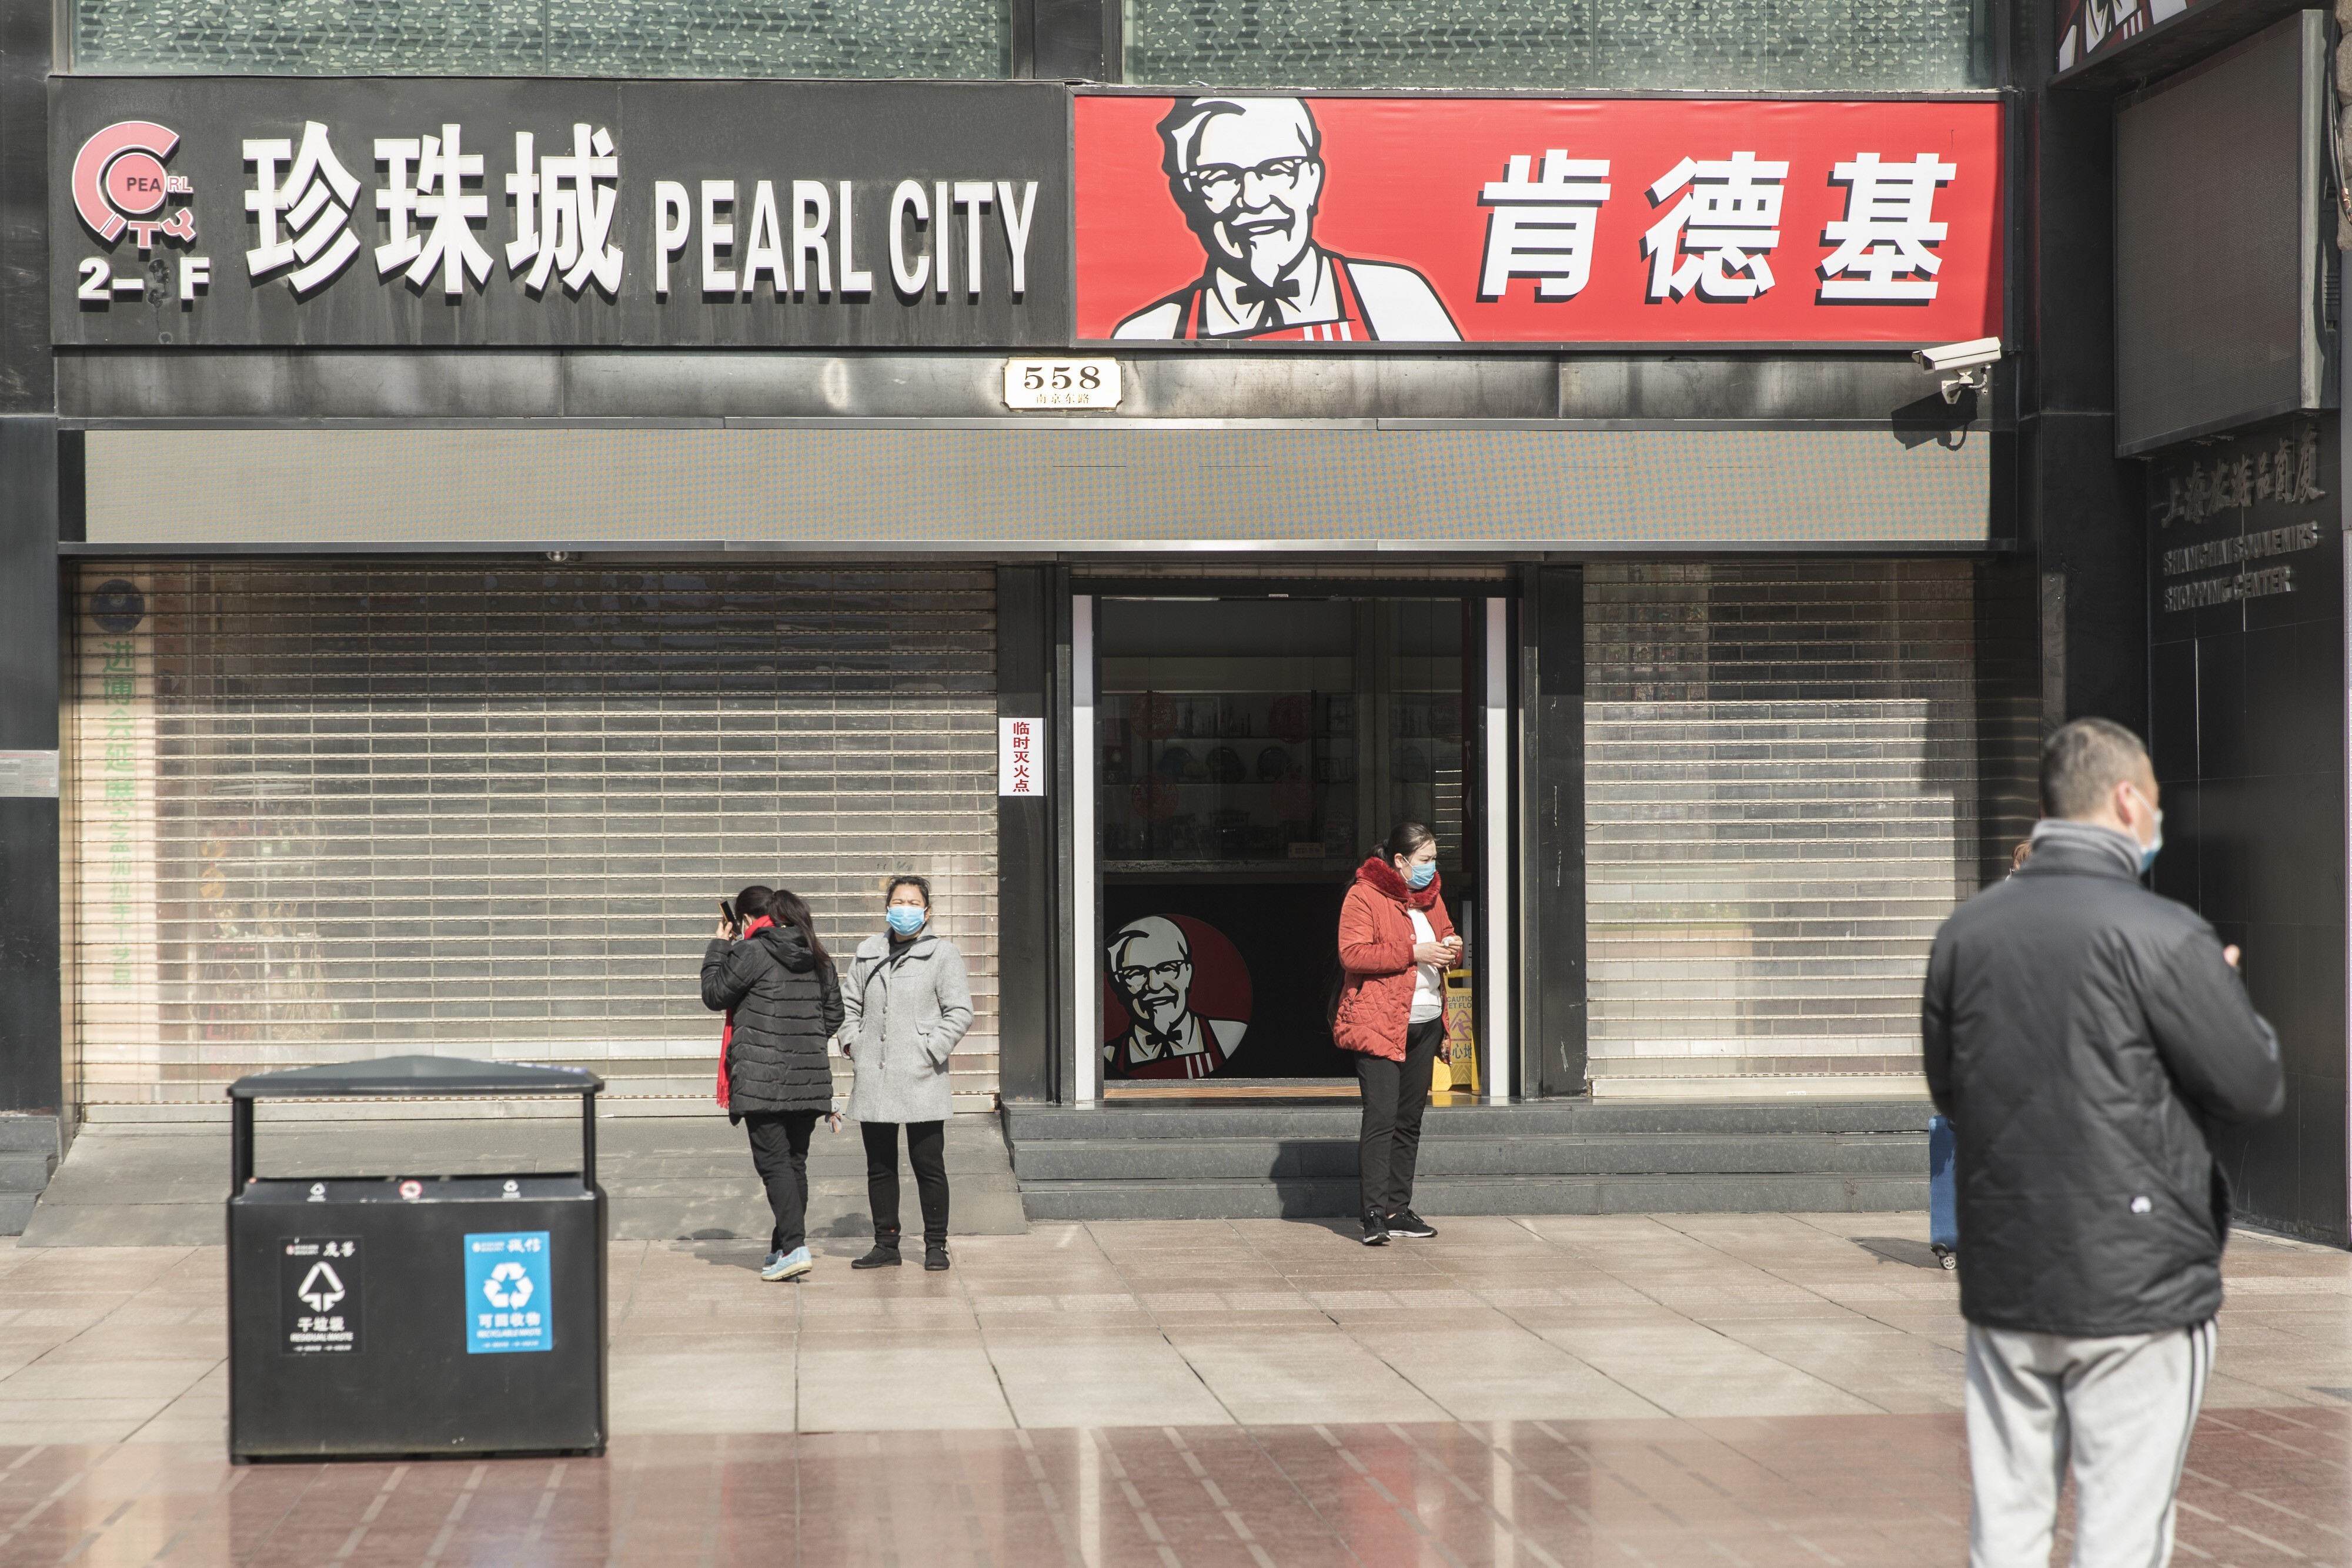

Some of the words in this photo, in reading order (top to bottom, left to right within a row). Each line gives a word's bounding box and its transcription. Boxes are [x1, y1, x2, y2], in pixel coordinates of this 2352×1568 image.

[242, 121, 624, 295] 珍珠城
[1477, 149, 1957, 306] 肯德基
[655, 180, 873, 293] PEARL
[889, 180, 1039, 295] CITY
[1024, 366, 1101, 389] 558
[1037, 393, 1090, 404] 南京东路
[2163, 539, 2233, 576] SHANGHAI
[2233, 520, 2318, 561] SOUVENIRS
[2164, 577, 2232, 613] SHOPPING
[2232, 565, 2291, 601] CENTER
[1013, 721, 1030, 793] 临时灭火点
[290, 1332, 327, 1343] RESIDUAL
[328, 1330, 354, 1342] WASTE
[477, 1311, 541, 1329] 可回收物
